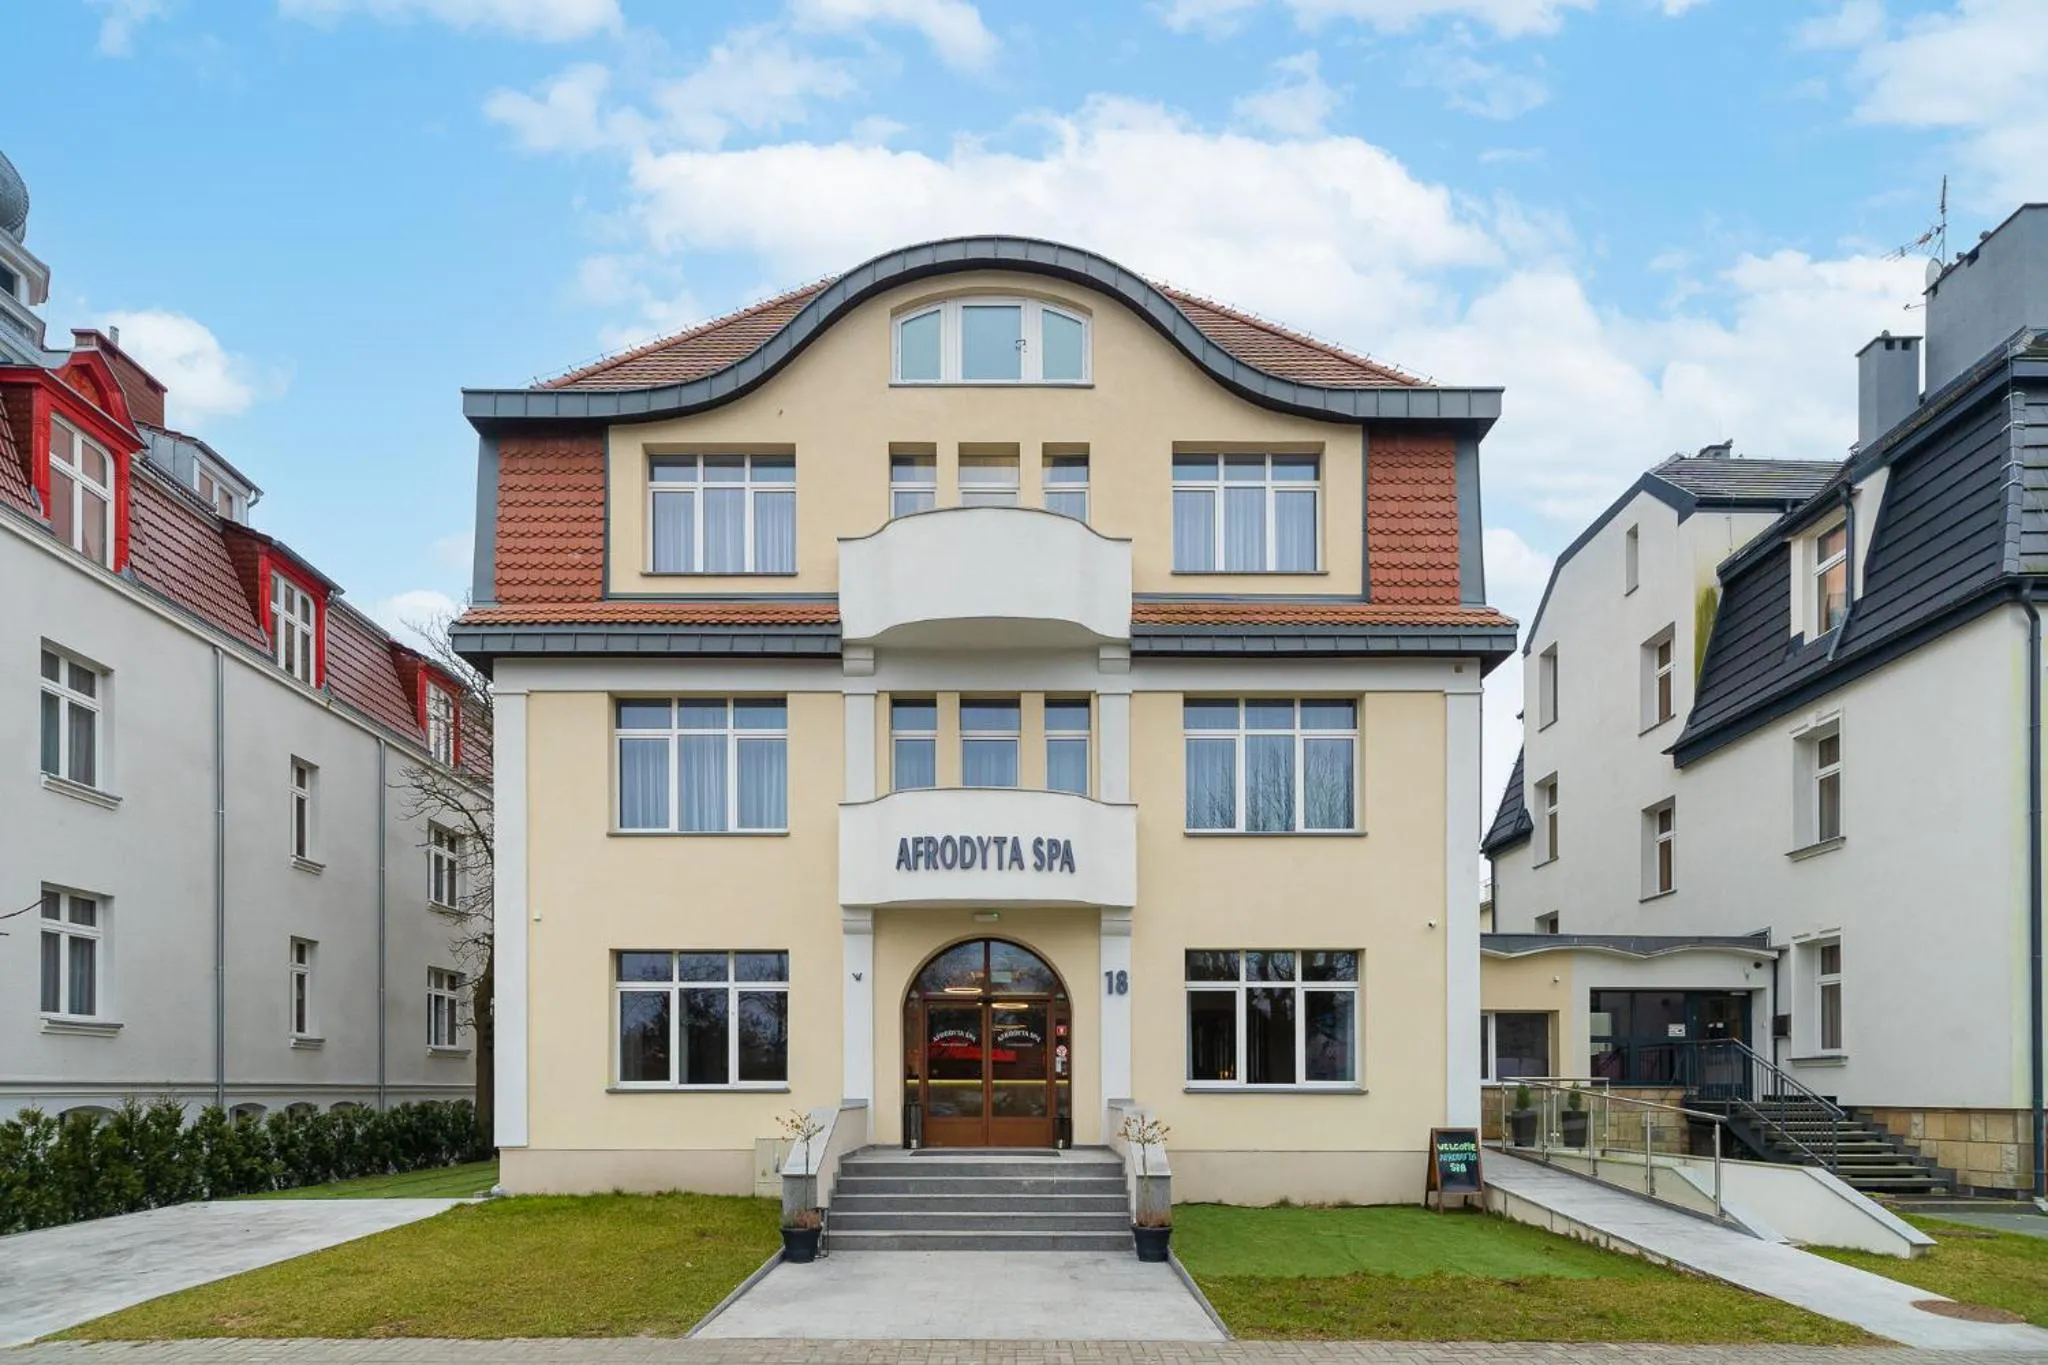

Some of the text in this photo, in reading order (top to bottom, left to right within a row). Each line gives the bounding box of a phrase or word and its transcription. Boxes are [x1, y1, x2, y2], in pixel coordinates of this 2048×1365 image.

[896, 835, 1076, 874] AFRODYTA SPA
[1104, 970, 1129, 996] 18
